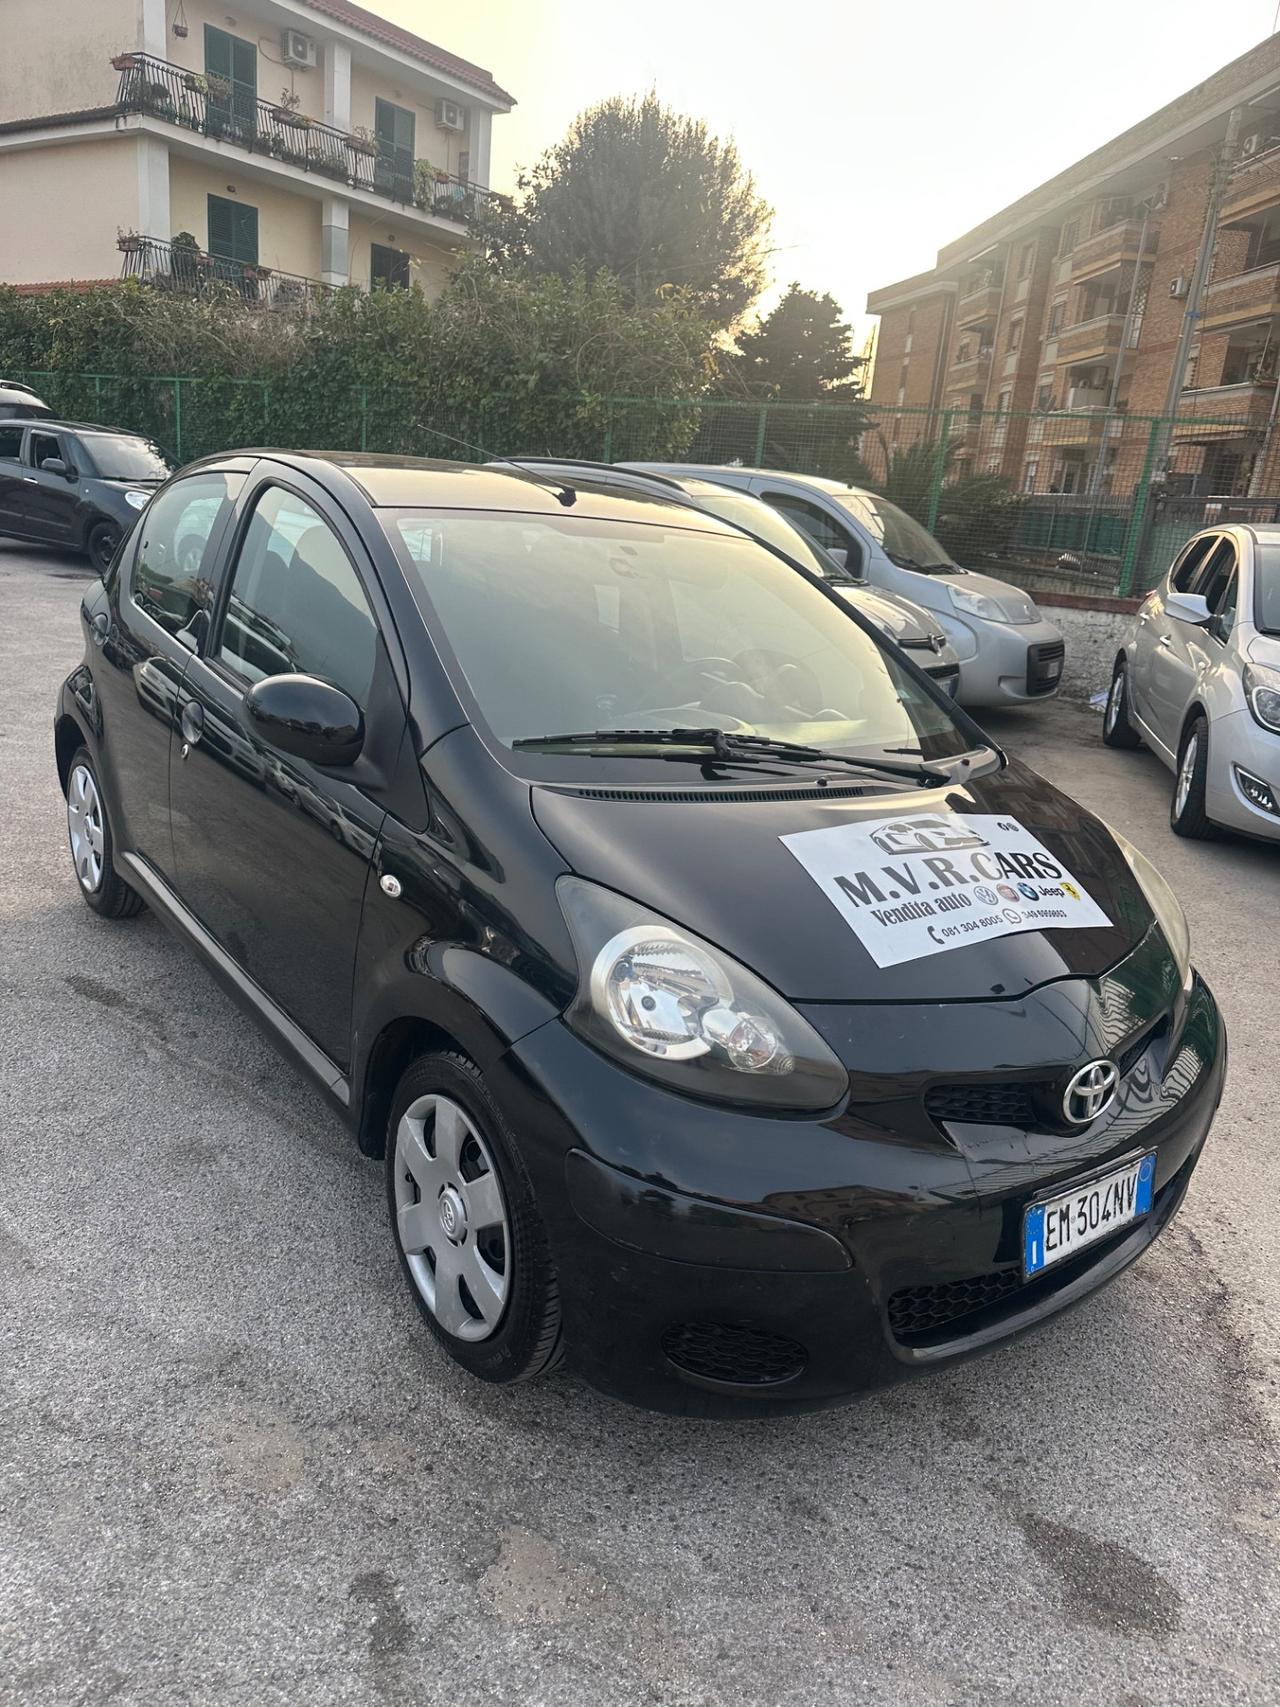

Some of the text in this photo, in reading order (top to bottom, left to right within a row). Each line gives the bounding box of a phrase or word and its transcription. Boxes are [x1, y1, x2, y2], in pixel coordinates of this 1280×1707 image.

[1038, 885, 1065, 898] Jeep
[871, 892, 972, 926] Vendita auto
[941, 915, 1003, 937] 081 304 8005
